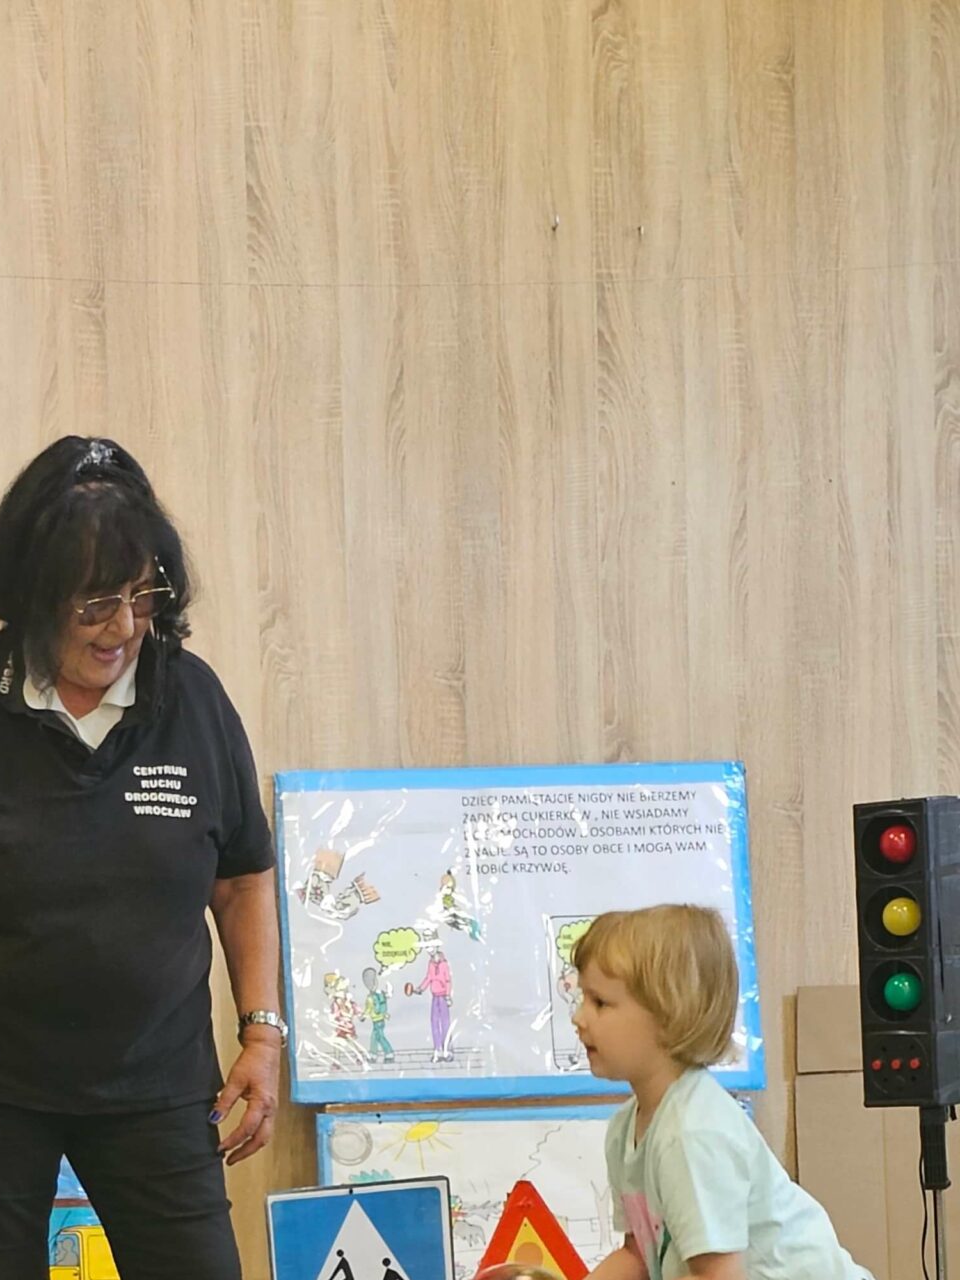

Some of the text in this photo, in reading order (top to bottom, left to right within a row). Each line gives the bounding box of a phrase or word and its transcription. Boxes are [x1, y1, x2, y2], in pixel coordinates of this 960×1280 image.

[133, 765, 187, 776] CENTRUM
[141, 779, 181, 790] RUCHU
[125, 792, 197, 805] DROGOWEGO
[578, 792, 613, 803] NIGDY
[617, 792, 634, 802] NIE
[640, 790, 696, 801] BIERZEMY
[134, 806, 191, 818] WROCŁAW
[602, 809, 619, 819] NIE
[623, 807, 688, 819] WSIADAMY
[590, 826, 645, 838] OSOBAMI
[649, 824, 701, 836] KTÓRYCH
[705, 824, 723, 834] NIE
[514, 846, 528, 858] SĄ
[532, 845, 547, 856] TO
[551, 844, 589, 855] OSOBY
[593, 843, 623, 854] OBCE
[634, 842, 672, 854] MOGĄ
[675, 841, 707, 852] WAM
